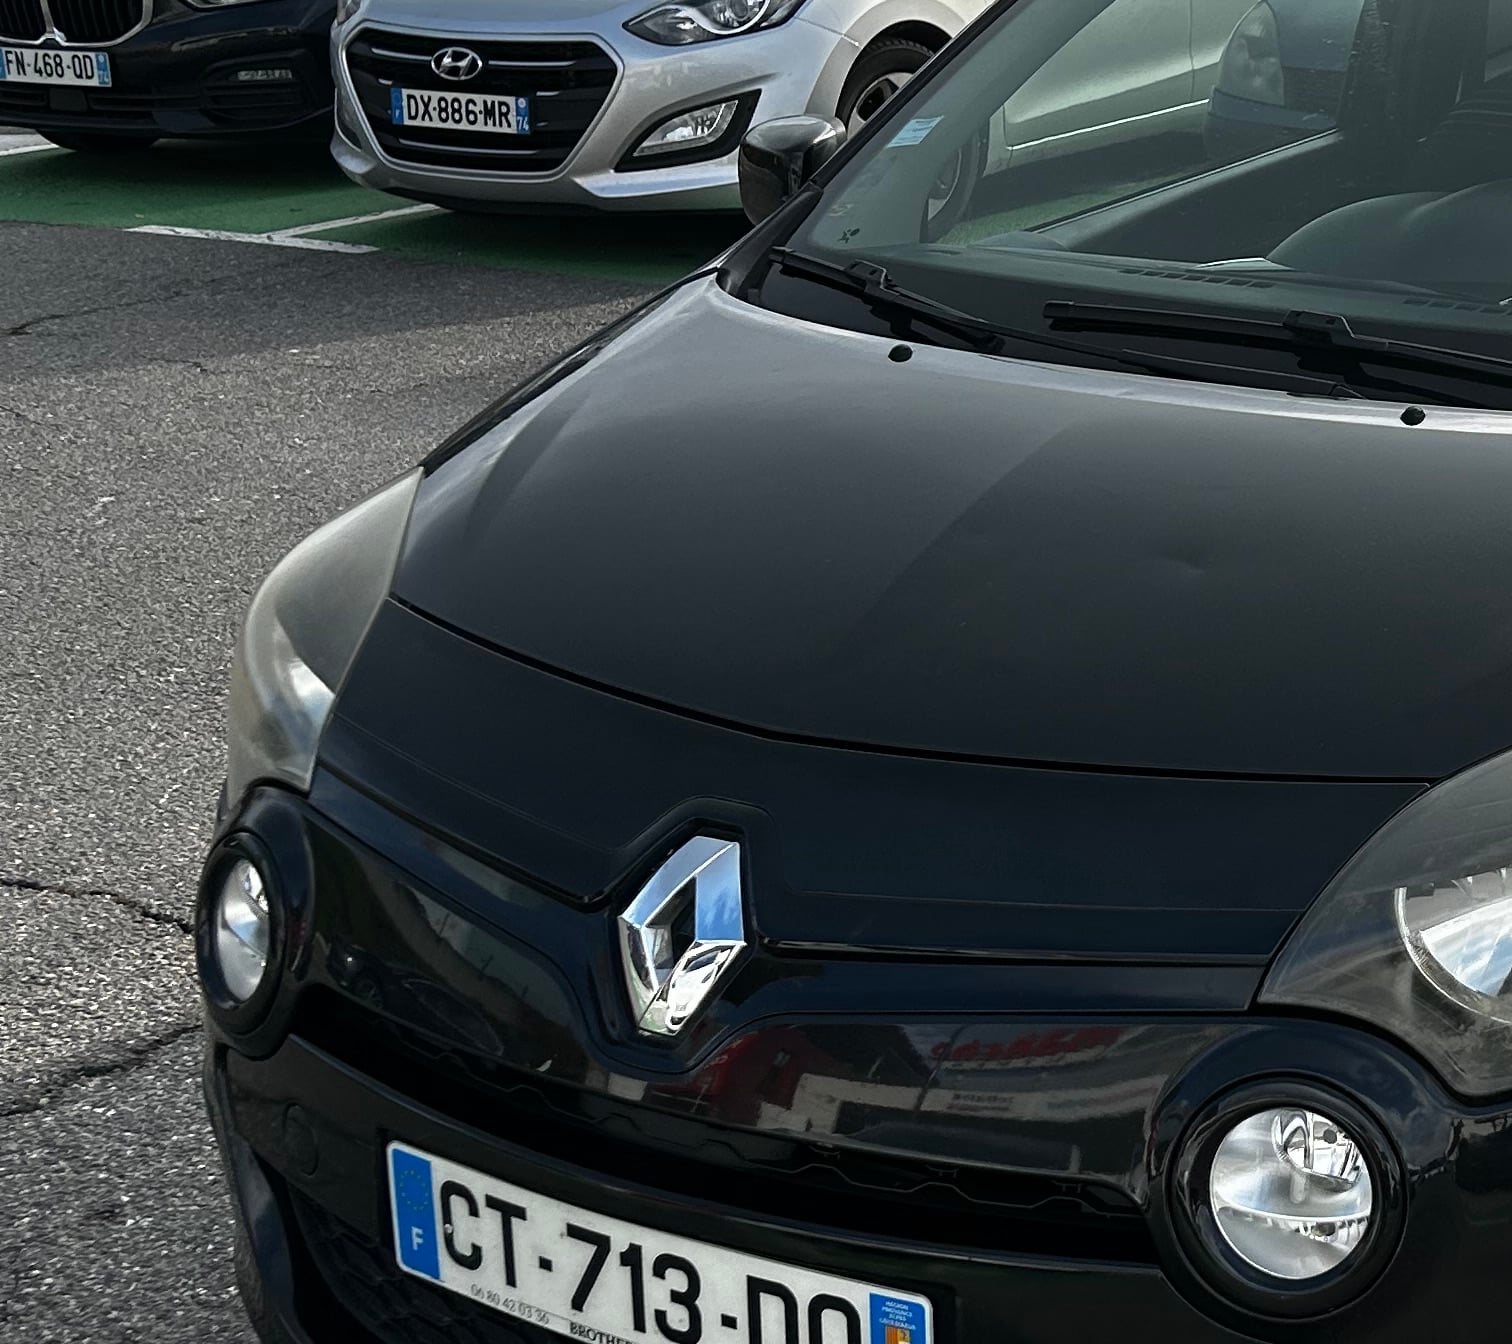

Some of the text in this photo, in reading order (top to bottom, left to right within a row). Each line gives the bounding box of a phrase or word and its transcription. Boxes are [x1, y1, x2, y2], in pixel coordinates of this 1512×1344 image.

[5, 50, 95, 80] FN-468-QD
[406, 94, 512, 128] DX-886-MR
[517, 116, 529, 131] 74
[411, 1226, 423, 1250] F
